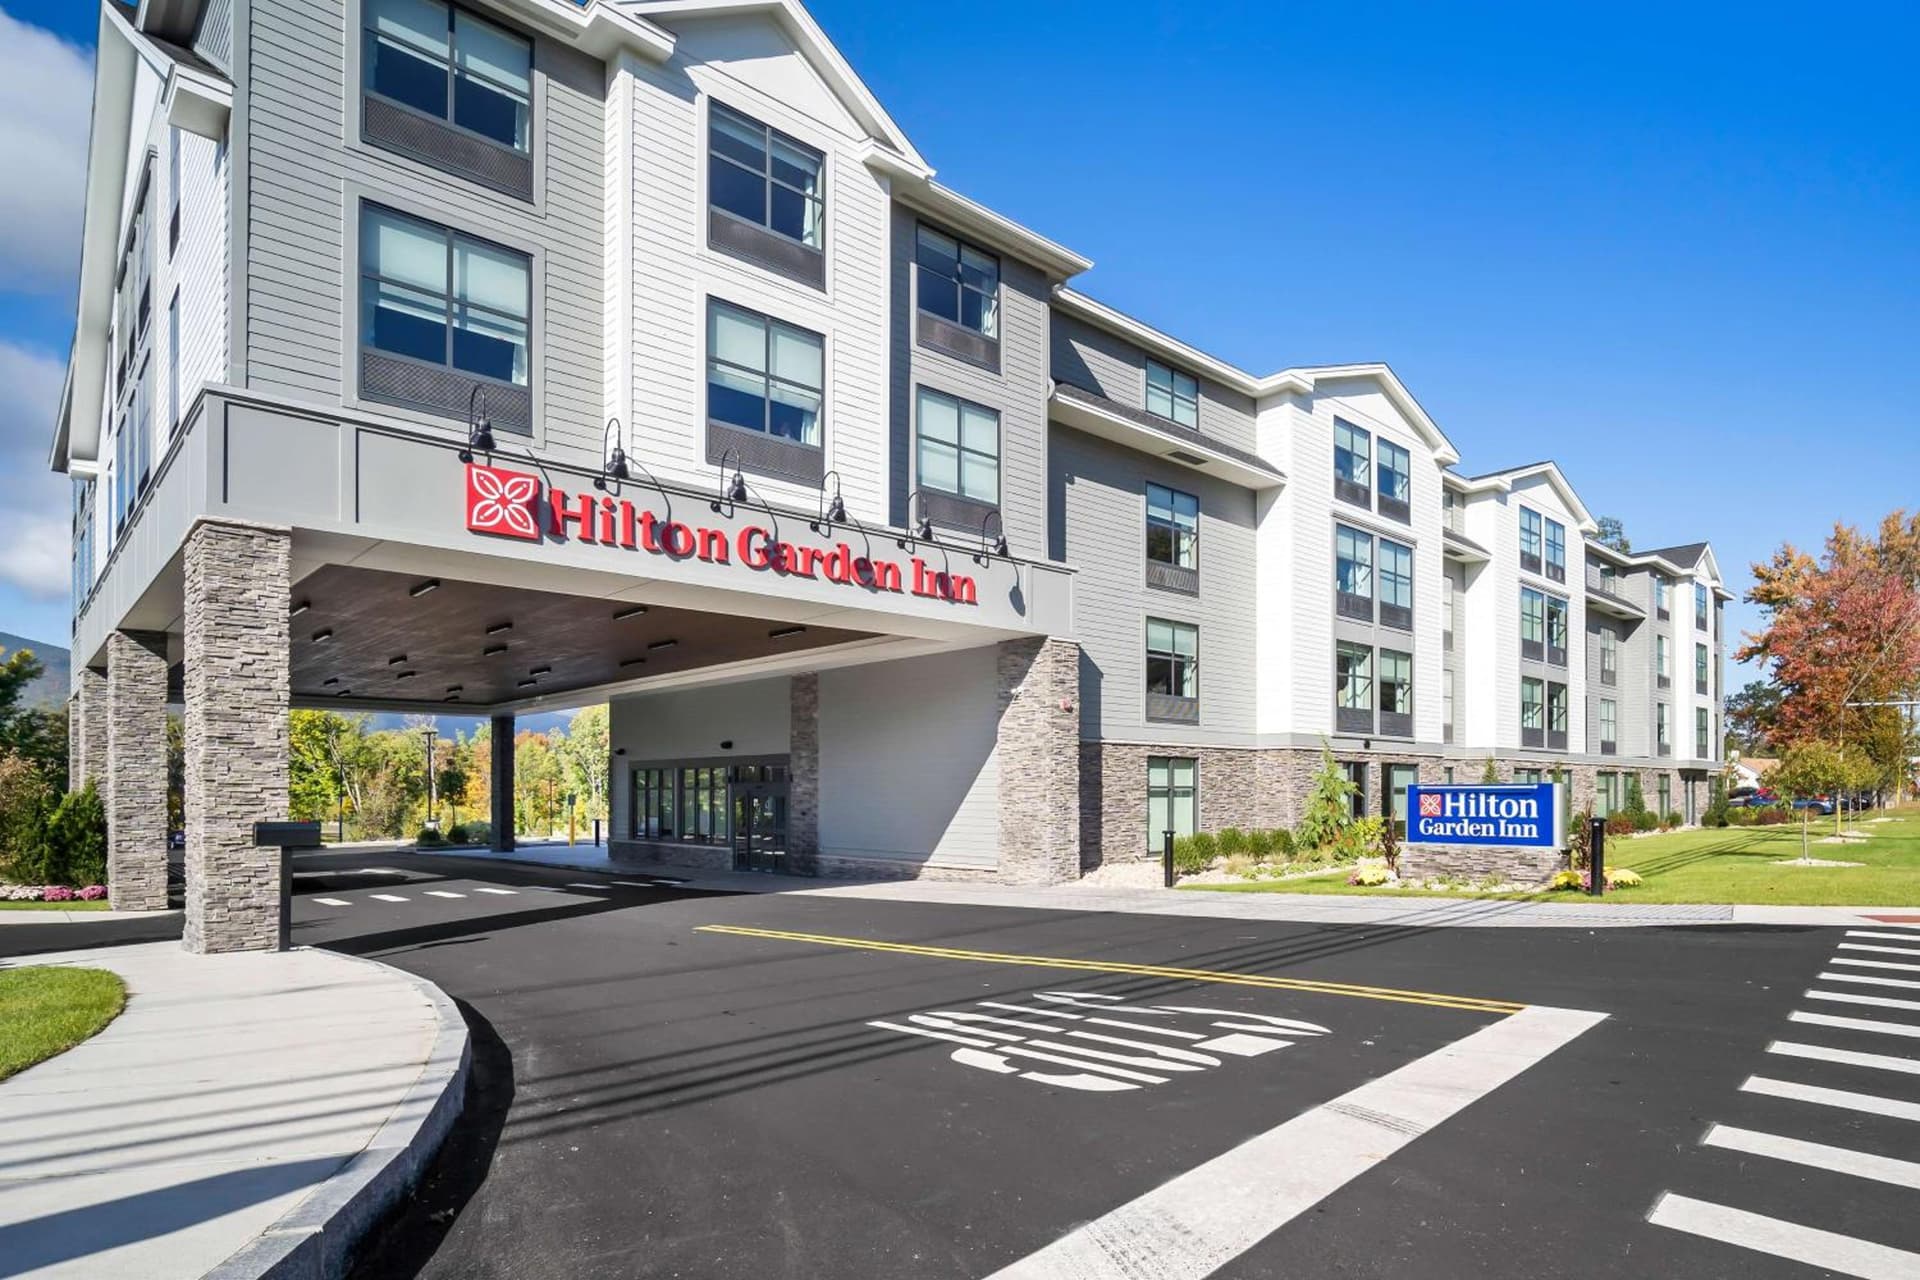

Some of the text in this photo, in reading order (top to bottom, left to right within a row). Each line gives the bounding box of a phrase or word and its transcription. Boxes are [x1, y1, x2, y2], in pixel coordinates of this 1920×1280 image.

[549, 487, 977, 604] Hilton Garden Inn
[1419, 817, 1538, 838] Garden Inn
[1445, 793, 1538, 818] Hilton
[865, 991, 1332, 1091] STOP
